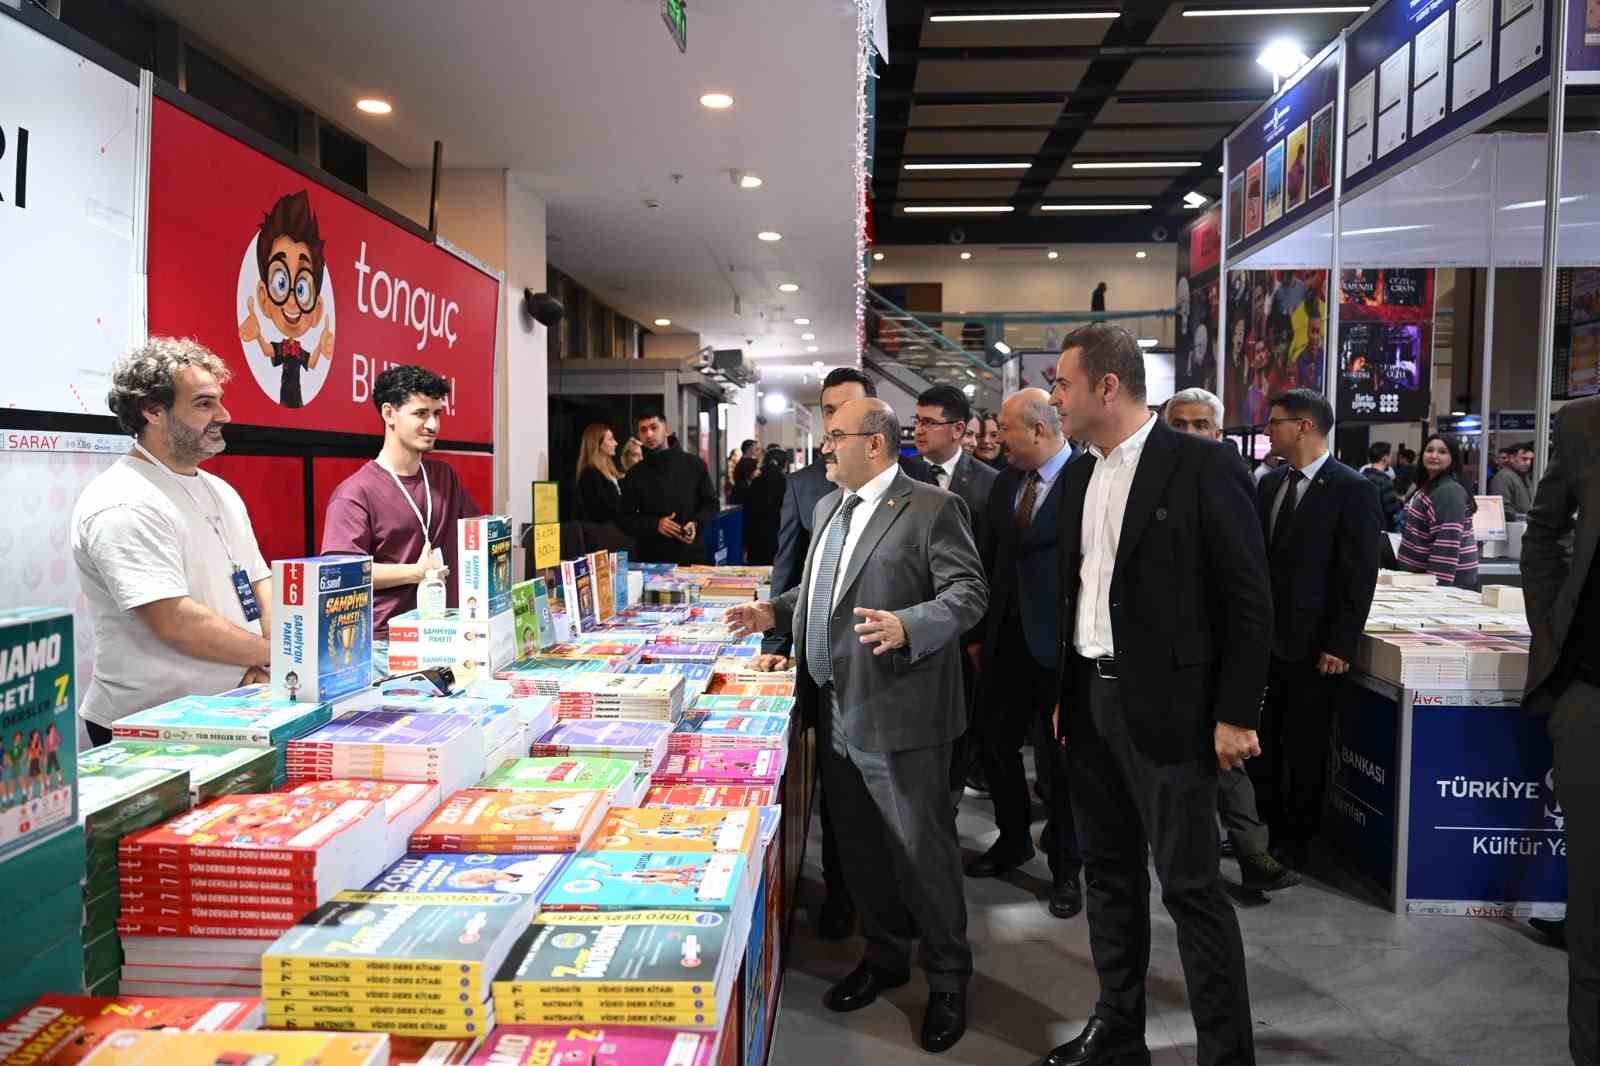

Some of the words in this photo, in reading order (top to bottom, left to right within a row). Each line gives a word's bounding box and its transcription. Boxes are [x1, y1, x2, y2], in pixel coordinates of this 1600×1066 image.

[354, 241, 459, 350] tonguç
[8, 435, 58, 450] SARAY
[289, 583, 298, 604] 6
[1342, 747, 1386, 785] BANKASI
[1436, 776, 1540, 800] TÜRKİYE
[1472, 835, 1543, 856] Kültür
[645, 912, 690, 922] VİDEO
